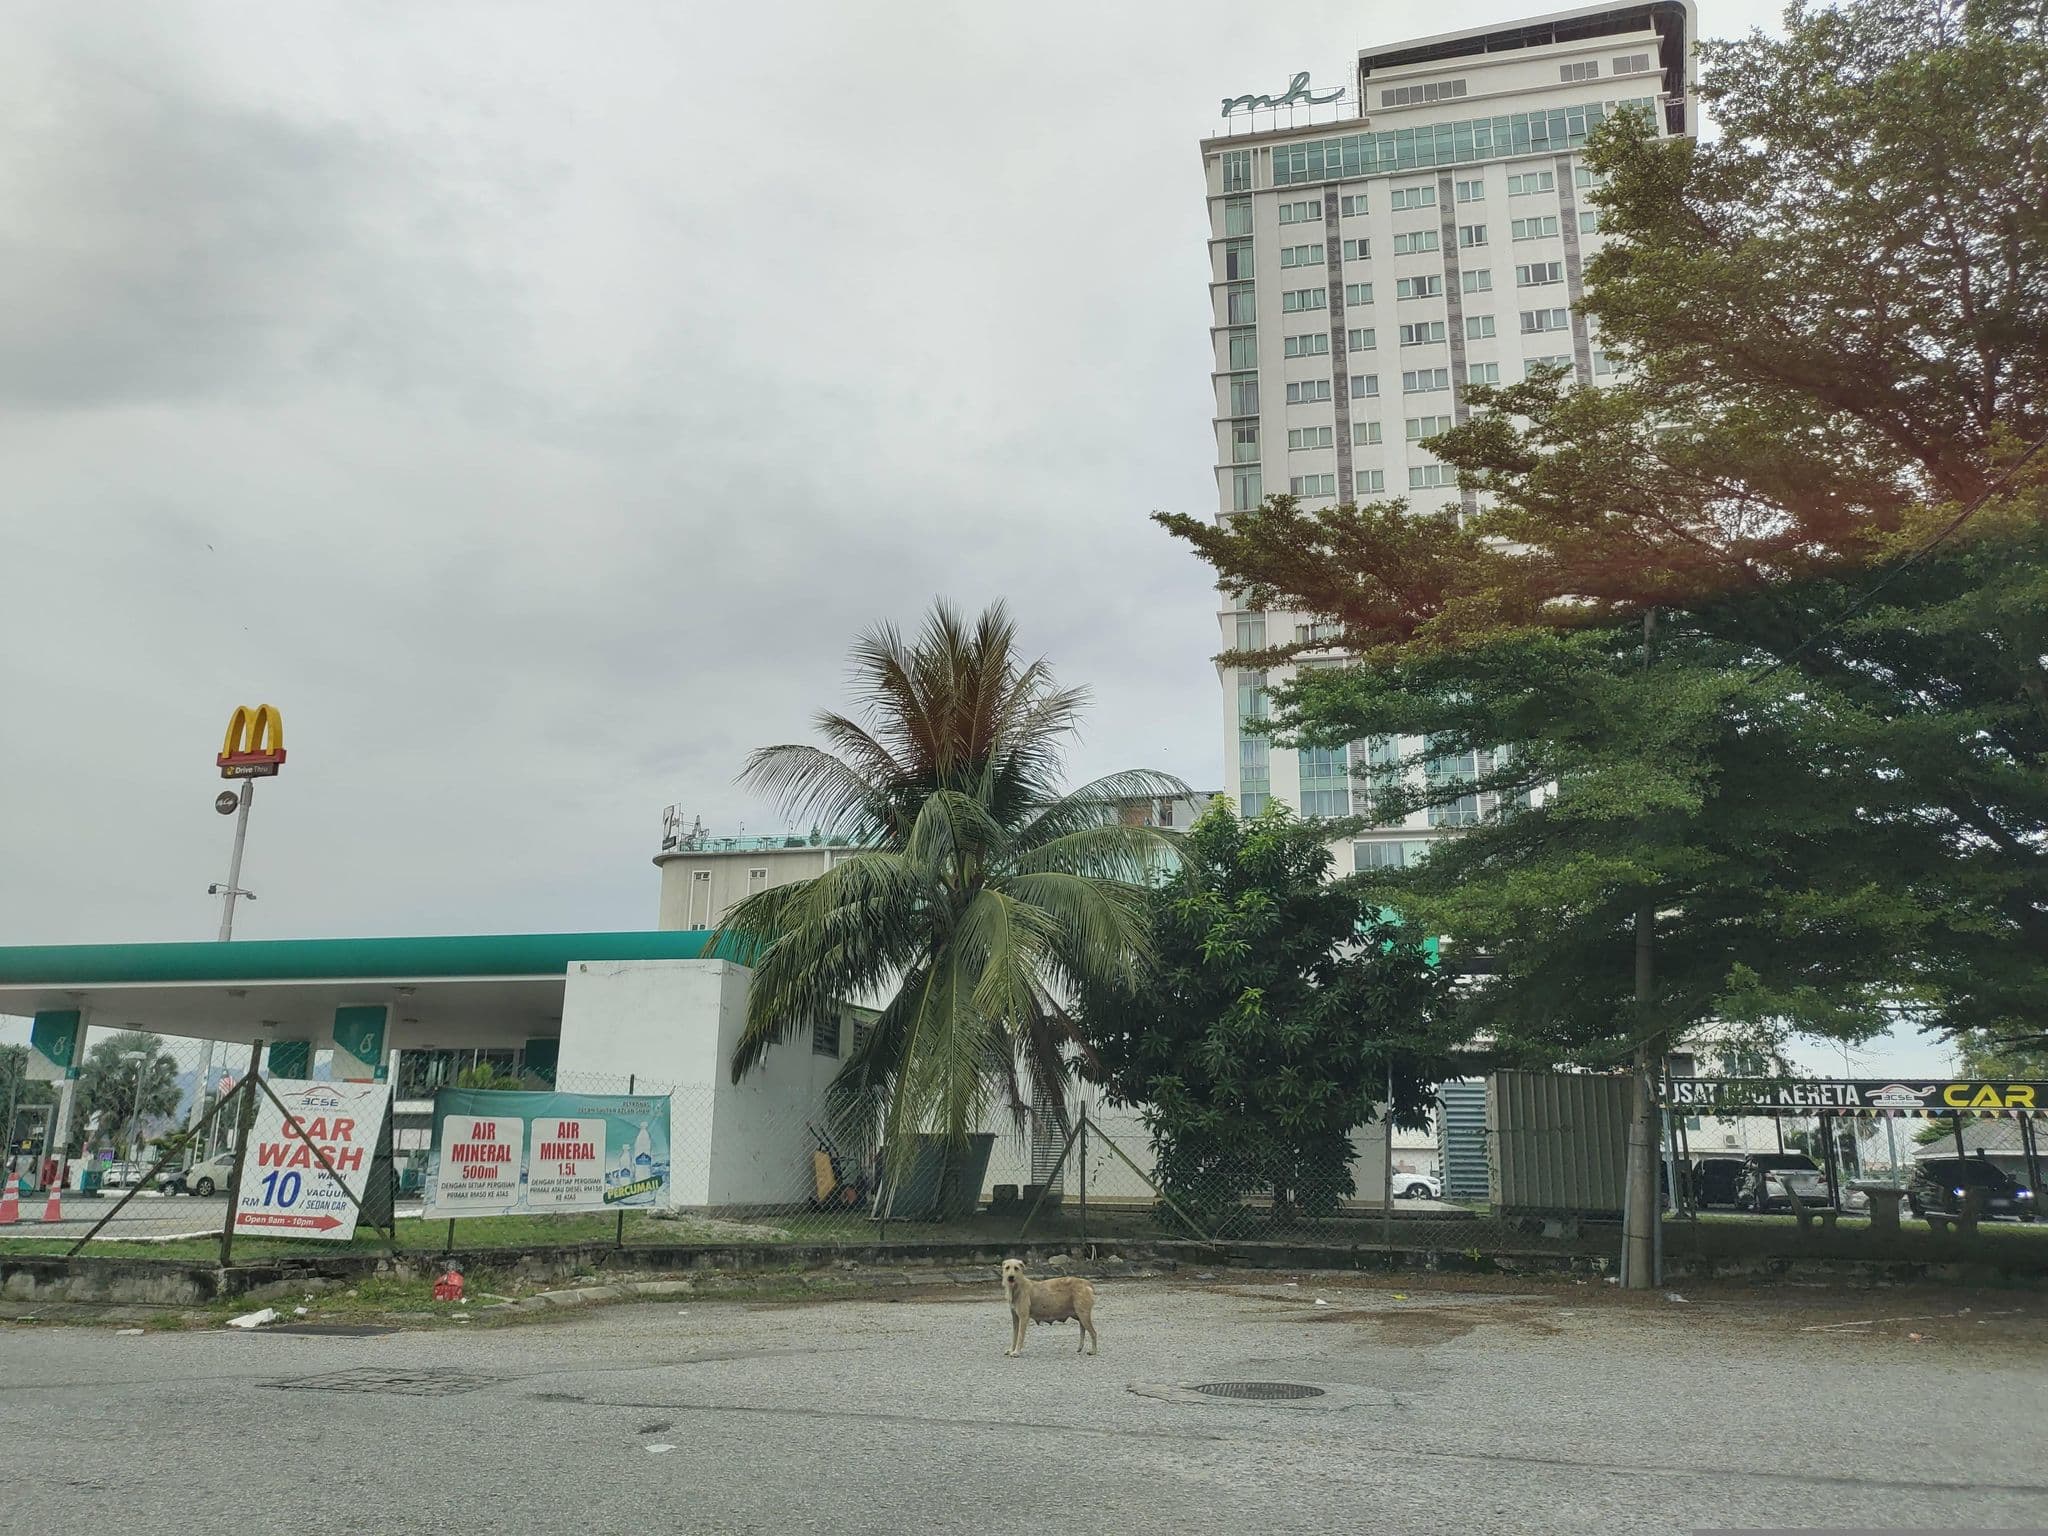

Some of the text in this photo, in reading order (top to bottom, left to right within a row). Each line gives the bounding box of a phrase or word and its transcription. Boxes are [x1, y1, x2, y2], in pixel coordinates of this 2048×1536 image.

[1779, 1084, 1860, 1105] KERETA
[1943, 1084, 2035, 1108] CAR
[281, 1116, 355, 1141] CAR
[472, 1122, 495, 1140] AIR
[558, 1121, 579, 1139] AIR
[258, 1142, 364, 1171] WASH
[451, 1143, 511, 1162] MINERAL
[540, 1142, 595, 1160] MINERAL
[318, 1172, 347, 1181] WAH
[462, 1165, 498, 1180] 500ml
[558, 1162, 576, 1176] 1.5L
[241, 1197, 260, 1207] RM
[261, 1170, 302, 1208] 10
[306, 1200, 330, 1210] SEDAN
[331, 1201, 347, 1211] CAR
[306, 1189, 350, 1198] VACUUM
[245, 1215, 266, 1225] Open
[293, 1217, 314, 1226] 10pm
